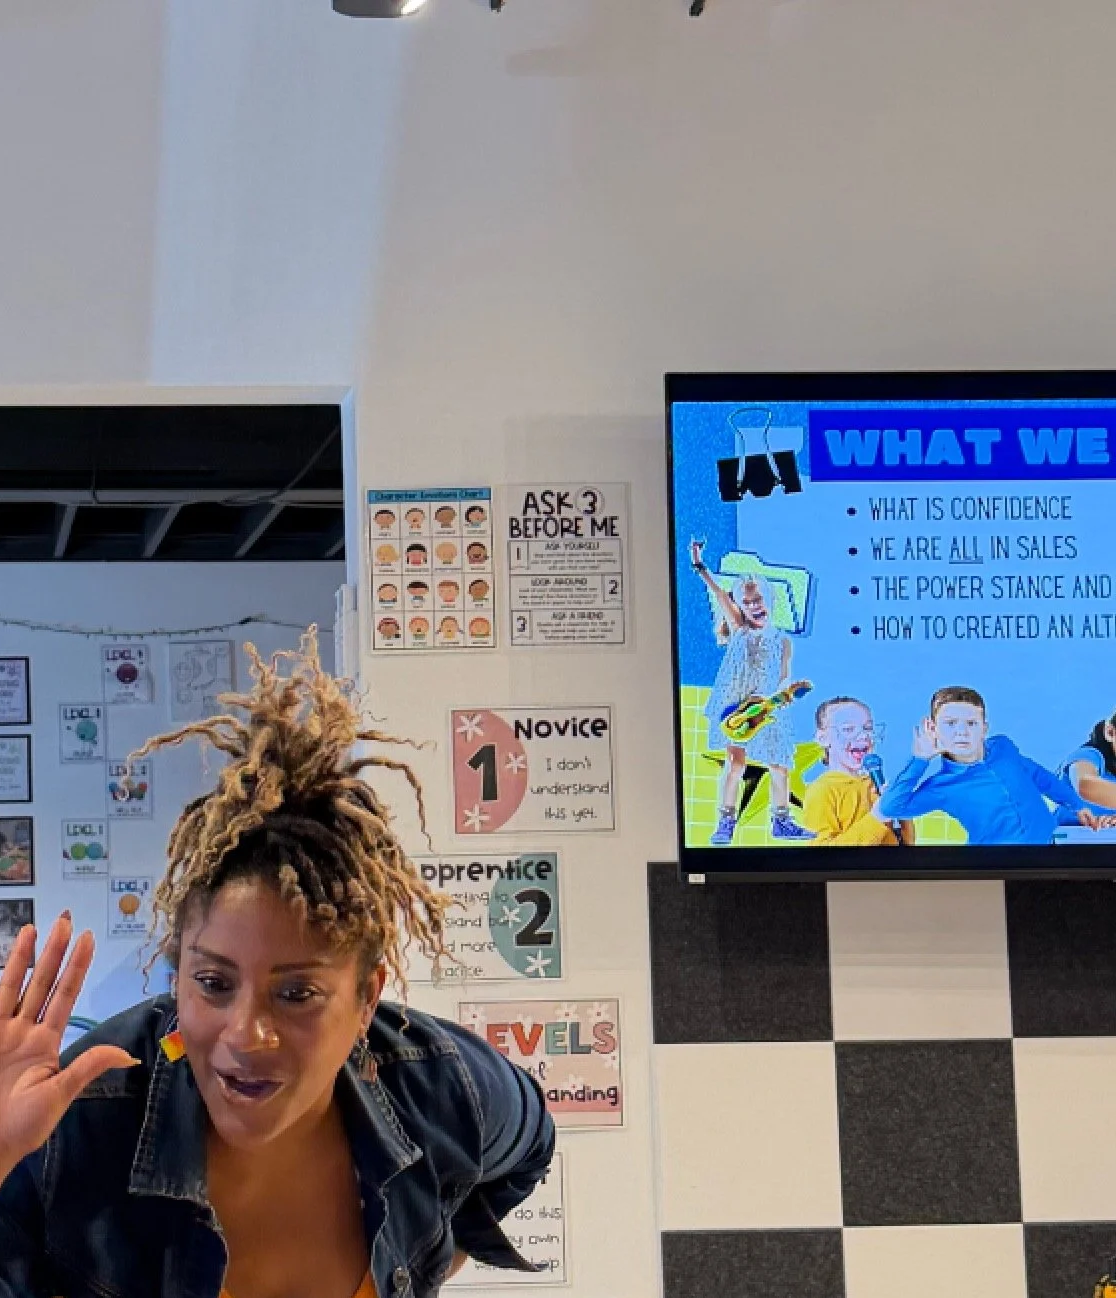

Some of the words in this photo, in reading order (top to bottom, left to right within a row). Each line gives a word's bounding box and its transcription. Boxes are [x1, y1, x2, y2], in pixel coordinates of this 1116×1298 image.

[823, 428, 1001, 467] WHAT
[1018, 427, 1110, 465] WE
[523, 490, 573, 515] ASK
[581, 490, 598, 515] 3
[869, 496, 918, 521] WHAT
[926, 496, 944, 521] IS
[951, 495, 1072, 521] CONFIDENCE
[509, 516, 583, 538] BEFORE
[591, 516, 619, 537] ME
[871, 536, 896, 561] WE
[903, 535, 942, 561] ARE
[949, 535, 983, 564] ALL
[991, 535, 1010, 560] IN
[1016, 535, 1078, 560] SALES
[608, 579, 619, 595] 2
[871, 575, 910, 600] THE
[916, 575, 984, 600] POWER
[991, 575, 1065, 600] STANCE
[1072, 574, 1112, 599] AND
[516, 615, 527, 633] 3
[873, 614, 914, 640] HOW
[920, 614, 948, 639] TO
[953, 614, 1040, 639] CREATED
[1047, 613, 1074, 639] AN
[1081, 613, 1116, 639] ALT
[514, 717, 609, 740] Novice
[467, 743, 498, 801] 1
[546, 757, 552, 772] I
[556, 756, 592, 771] don't
[530, 782, 610, 795] understand
[544, 806, 567, 820] this
[420, 859, 554, 888] pprentice
[514, 888, 553, 947] 2
[461, 1021, 618, 1056] EVELS
